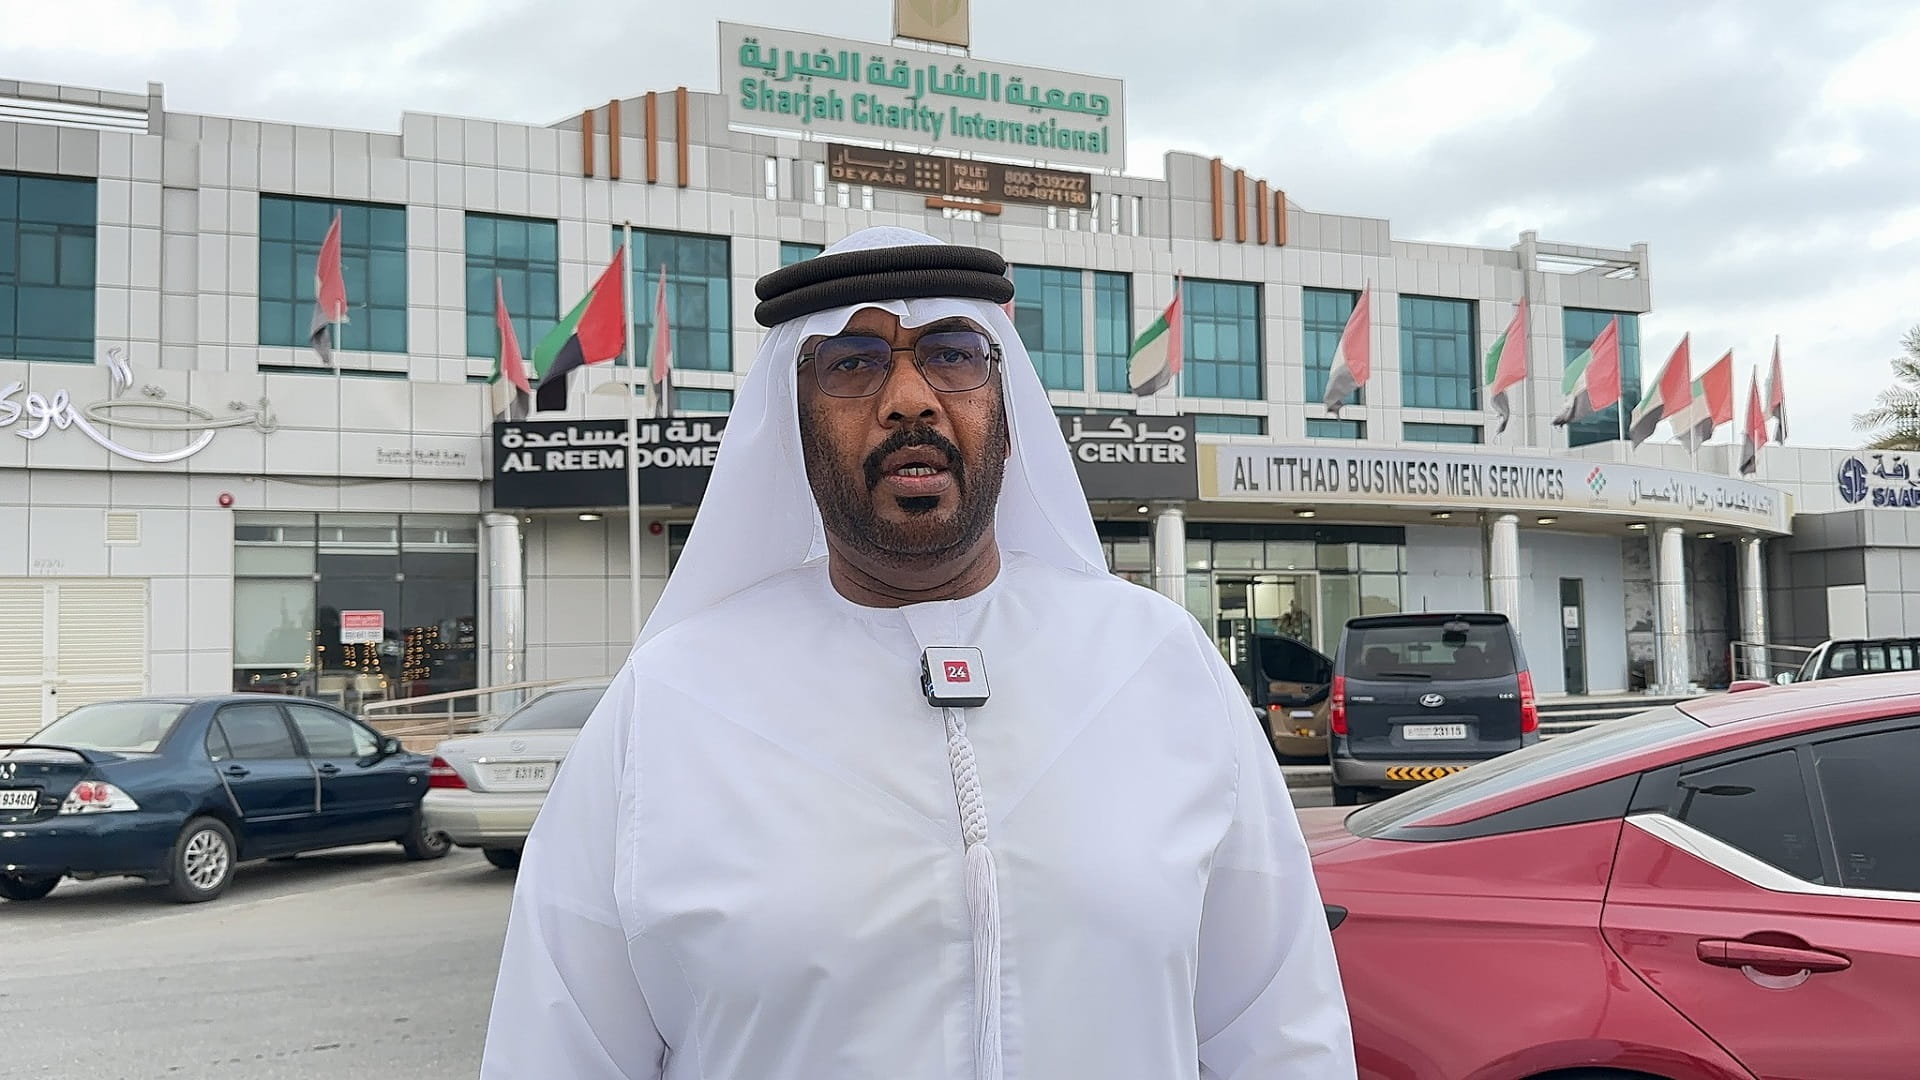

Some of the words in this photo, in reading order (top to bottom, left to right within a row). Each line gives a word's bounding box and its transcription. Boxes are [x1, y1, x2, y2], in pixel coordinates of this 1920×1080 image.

[740, 37, 860, 82] الخيرية
[867, 56, 1000, 103] الشارقة
[1006, 76, 1110, 122] جمعية
[741, 78, 845, 124] Sharjah
[853, 93, 945, 141] Charity
[951, 106, 1109, 154] International
[831, 166, 908, 185] DEYAAR
[953, 164, 969, 177] TO
[969, 166, 988, 179] LET
[1004, 169, 1086, 191] 800-339227
[1004, 184, 1087, 205] 050-4971150
[501, 423, 661, 449] المساعدة
[1069, 416, 1187, 443] مركز
[502, 452, 541, 473] AL
[546, 449, 625, 471] REEM
[1077, 442, 1187, 464] CENTER
[1233, 456, 1259, 491] AL
[1266, 457, 1340, 492] ITTHAD
[1347, 459, 1440, 496] BUSINESS
[1446, 462, 1483, 498] MEN
[1488, 464, 1565, 501] SERVICES
[1687, 484, 1715, 514] رجال
[947, 666, 967, 678] 24
